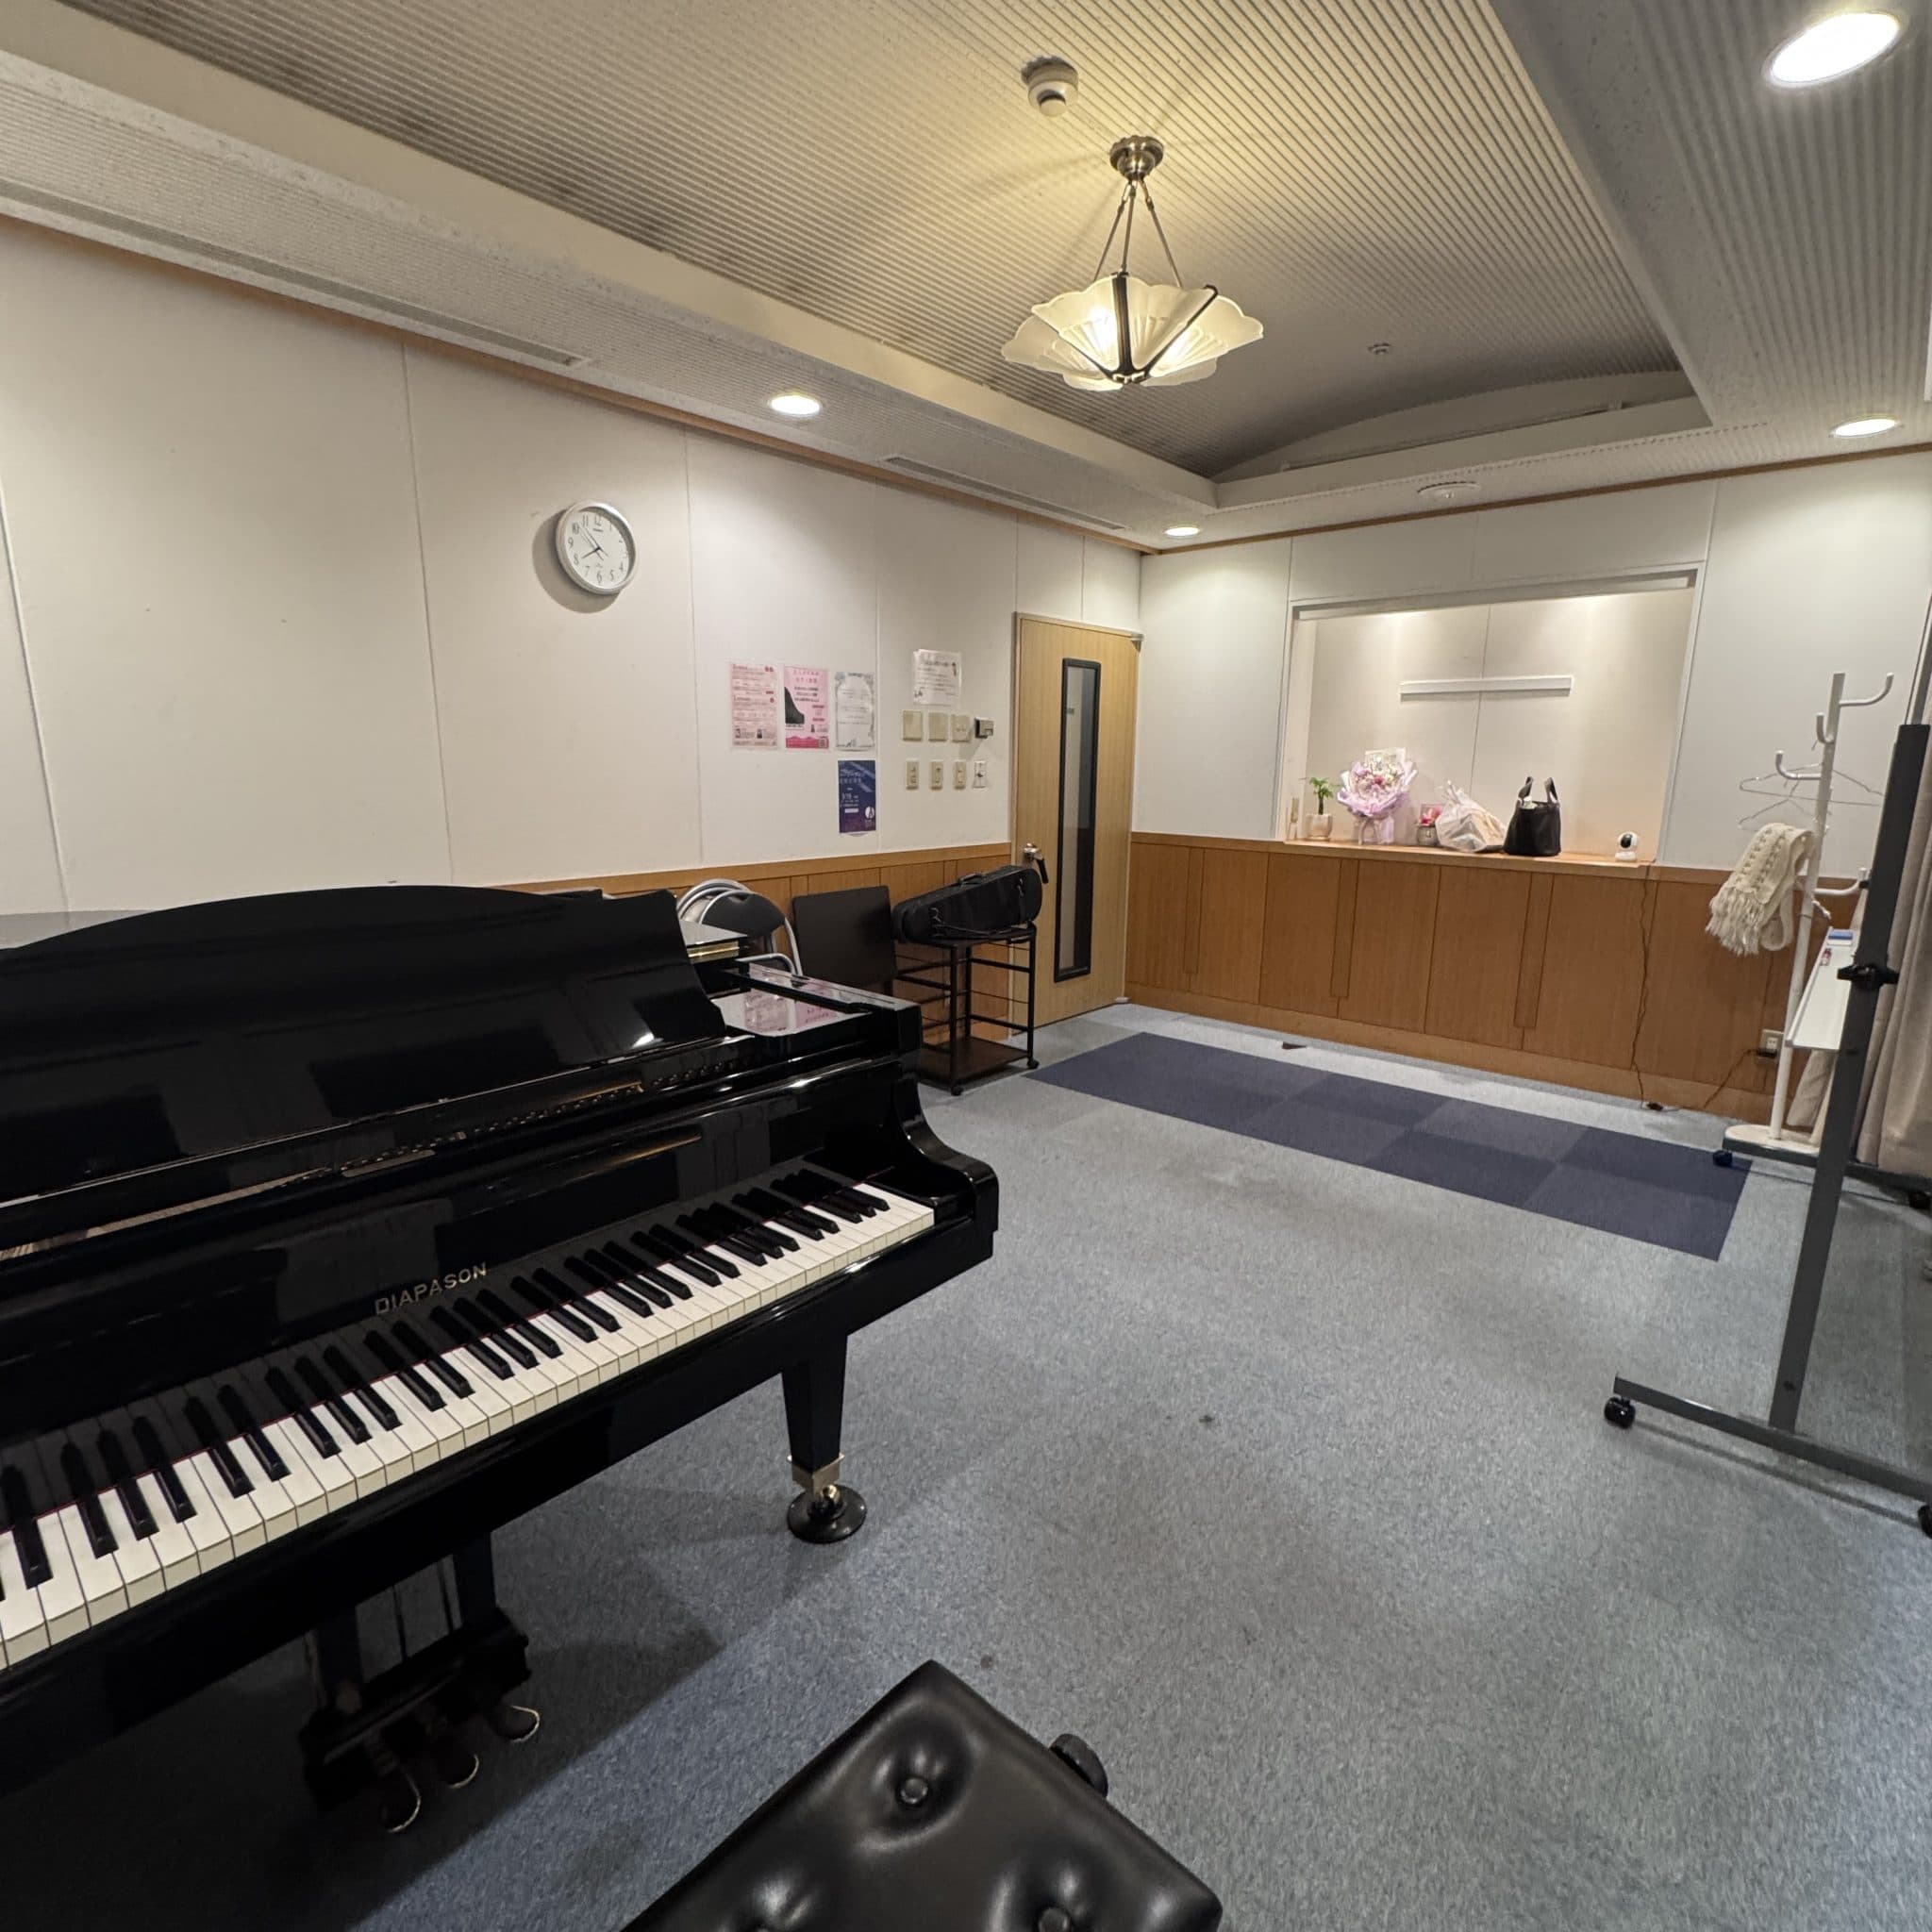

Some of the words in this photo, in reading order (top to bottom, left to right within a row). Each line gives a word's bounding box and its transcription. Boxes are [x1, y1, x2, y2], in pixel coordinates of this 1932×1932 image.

[572, 523, 579, 535] 10
[568, 537, 574, 549] 9
[574, 553, 579, 565] 8
[586, 565, 591, 576] 7
[610, 569, 615, 582] 5
[596, 571, 602, 584] 6
[375, 1261, 487, 1314] DIAPASON
